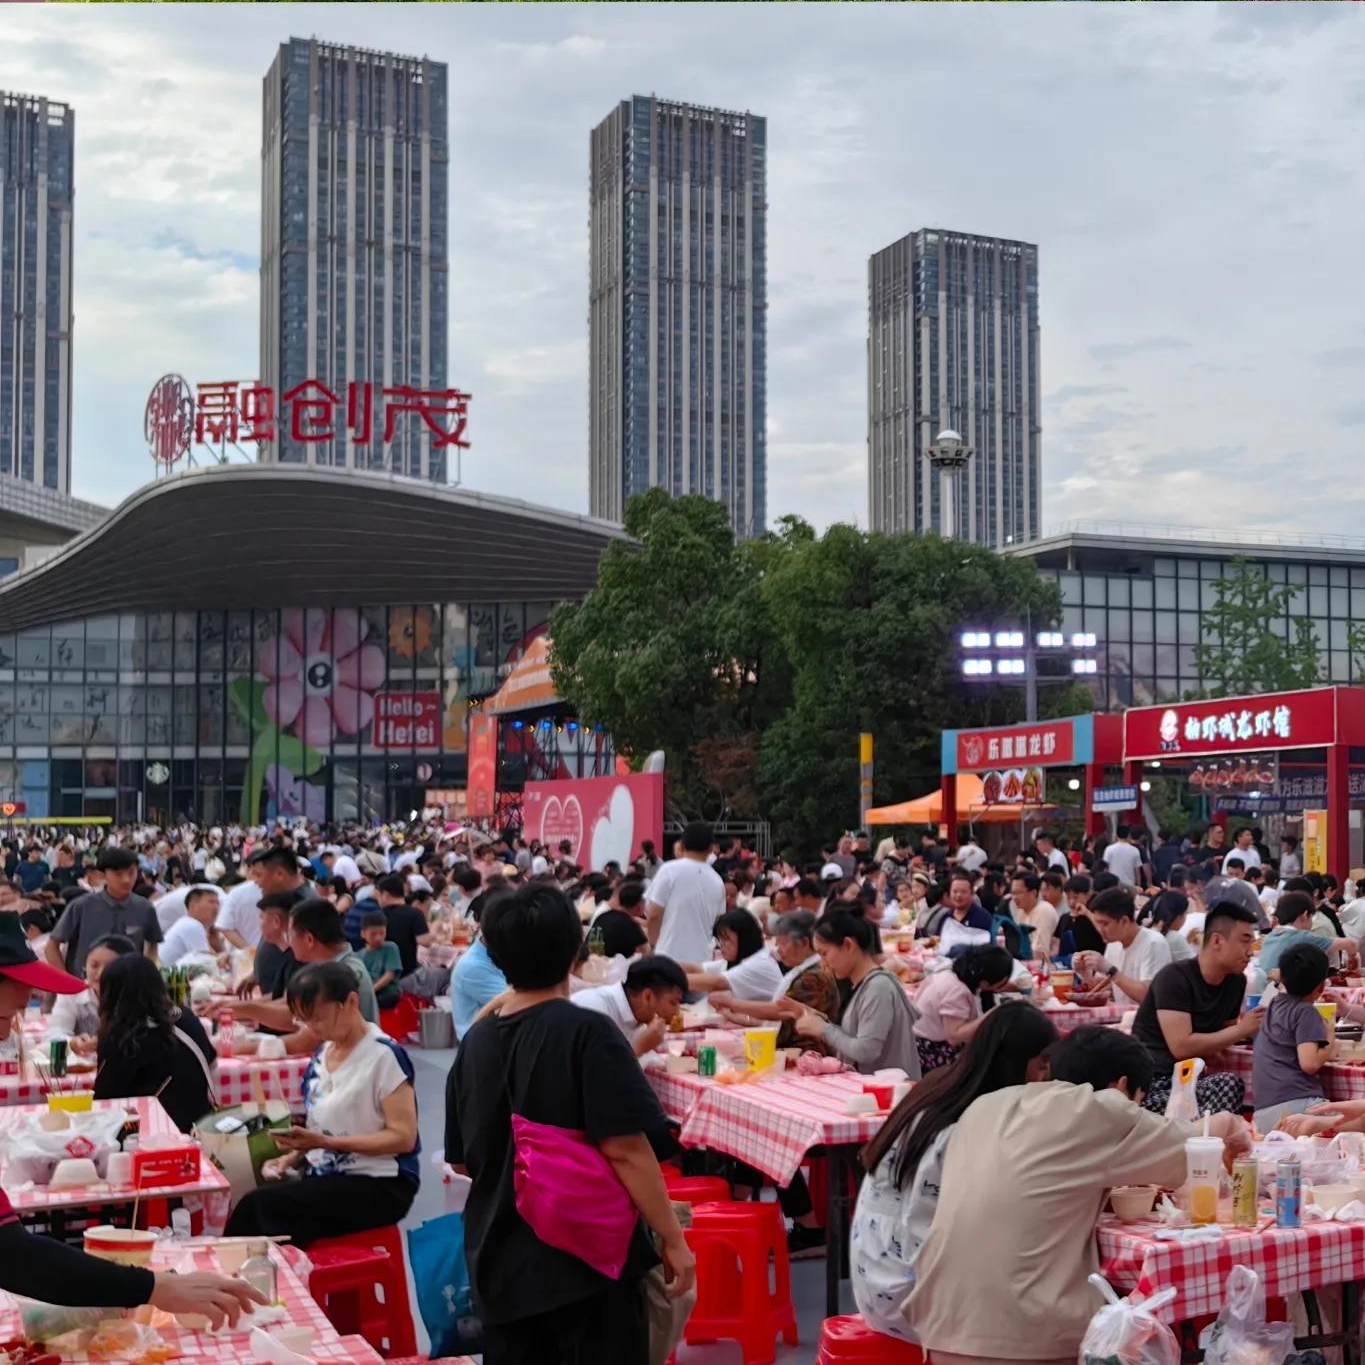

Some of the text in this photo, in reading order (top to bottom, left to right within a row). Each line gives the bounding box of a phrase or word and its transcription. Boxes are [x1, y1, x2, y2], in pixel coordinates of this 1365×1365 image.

[196, 380, 472, 449] 融创茂
[380, 698, 423, 717] Hello
[379, 720, 434, 744] Hefei
